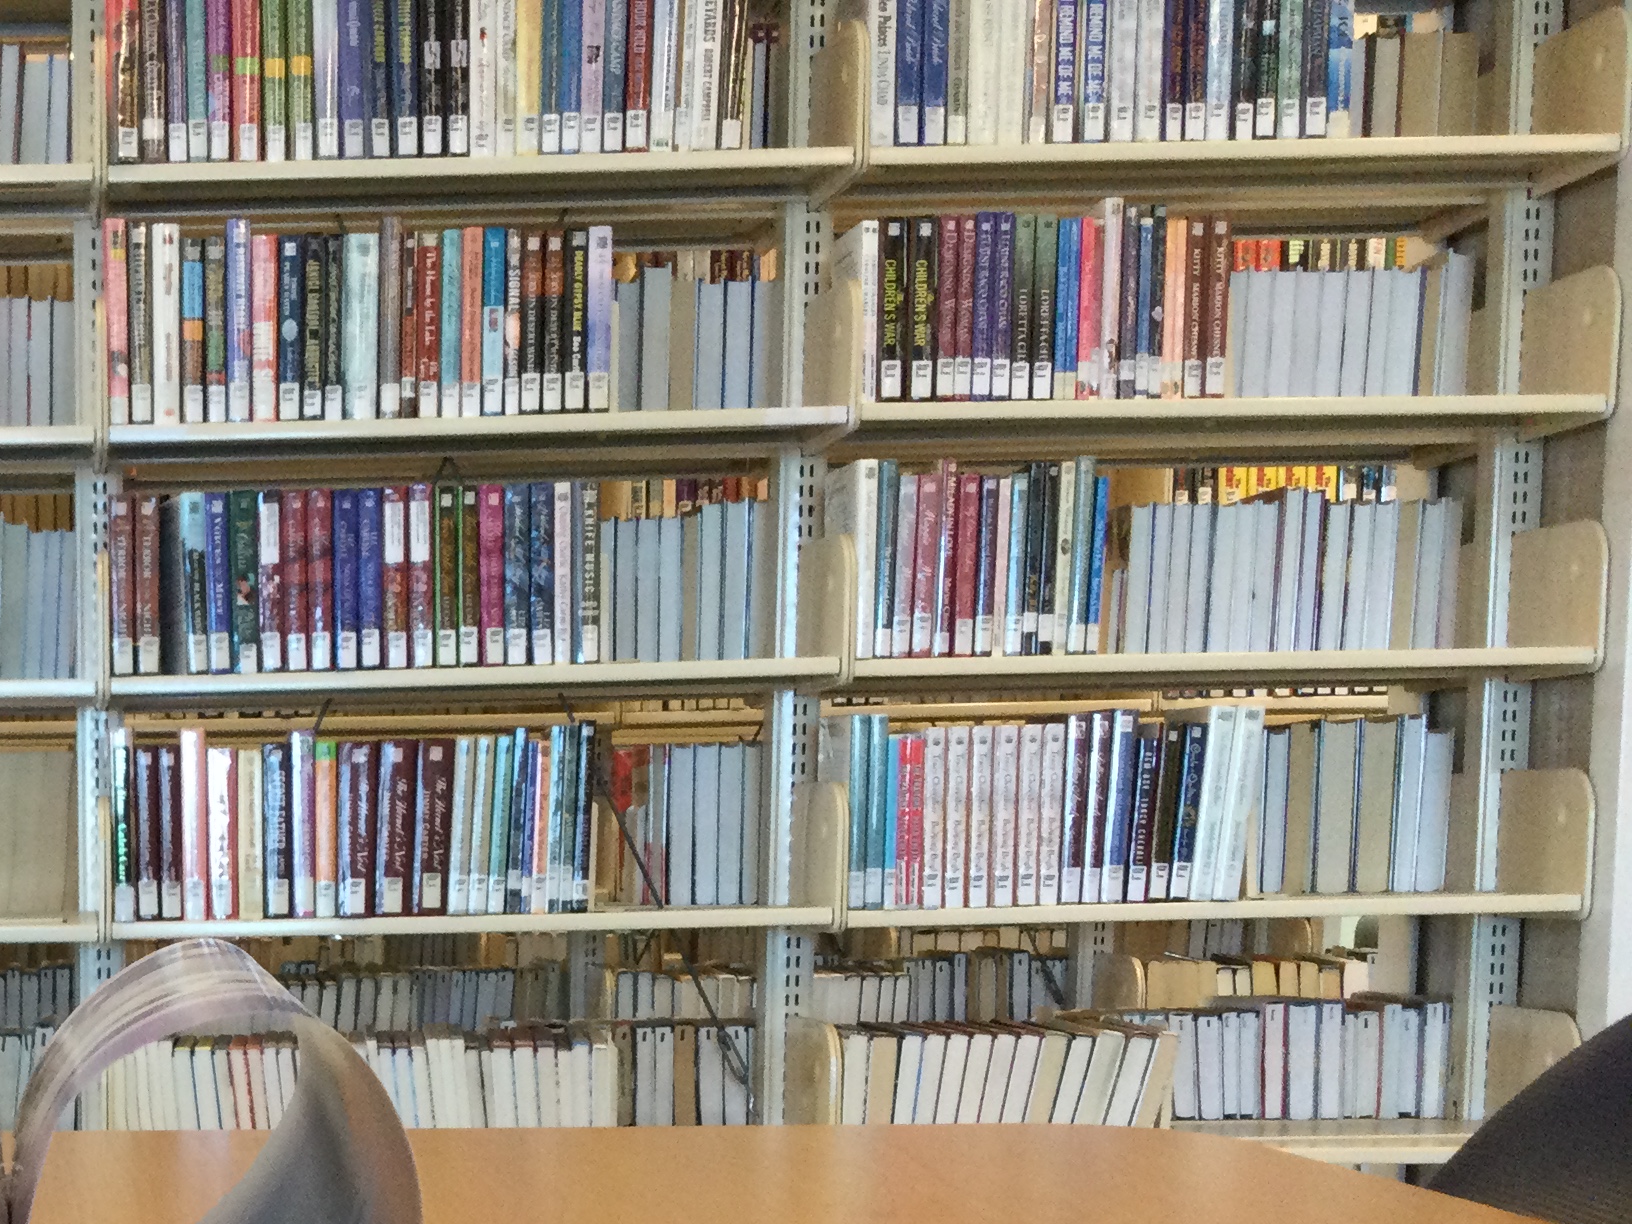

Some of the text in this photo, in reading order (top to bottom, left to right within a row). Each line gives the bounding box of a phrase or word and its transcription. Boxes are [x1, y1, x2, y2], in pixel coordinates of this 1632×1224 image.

[878, 15, 892, 47] Palaces
[1059, 5, 1075, 44] REMIND
[1089, 3, 1104, 42] REMIND
[1058, 47, 1073, 62] ME
[1088, 45, 1103, 60] ME
[1058, 81, 1072, 96] ME
[1086, 80, 1102, 94] ME
[574, 250, 584, 280] DEADLY
[943, 232, 958, 292] DESIGNING
[961, 232, 975, 293] DESIGNING
[1192, 248, 1202, 276] KITTY
[1216, 246, 1225, 274] KITTY
[423, 250, 436, 346] The House by the Lake
[508, 269, 521, 311] SIGNAL
[574, 282, 583, 308] GYPSY
[914, 260, 928, 346] CHILDREN'S WAR
[1191, 282, 1201, 322] MARION
[1214, 281, 1224, 319] MARION
[1018, 288, 1028, 339] LORETTA
[1039, 288, 1050, 339] LORETTA
[884, 322, 896, 346] WAR
[946, 476, 956, 515] MILADY
[946, 518, 954, 530] IN
[117, 535, 126, 578] TERROR
[142, 536, 153, 578] TERROR
[584, 509, 595, 593] KNIFE MUSIC
[946, 531, 955, 557] LOVE
[422, 790, 431, 859] JIMMY CARTER
[433, 776, 447, 870] The Hornet's Nest
[118, 823, 127, 881] Caleb Carr
[356, 844, 367, 874] Nest
[392, 842, 404, 872] Nest
